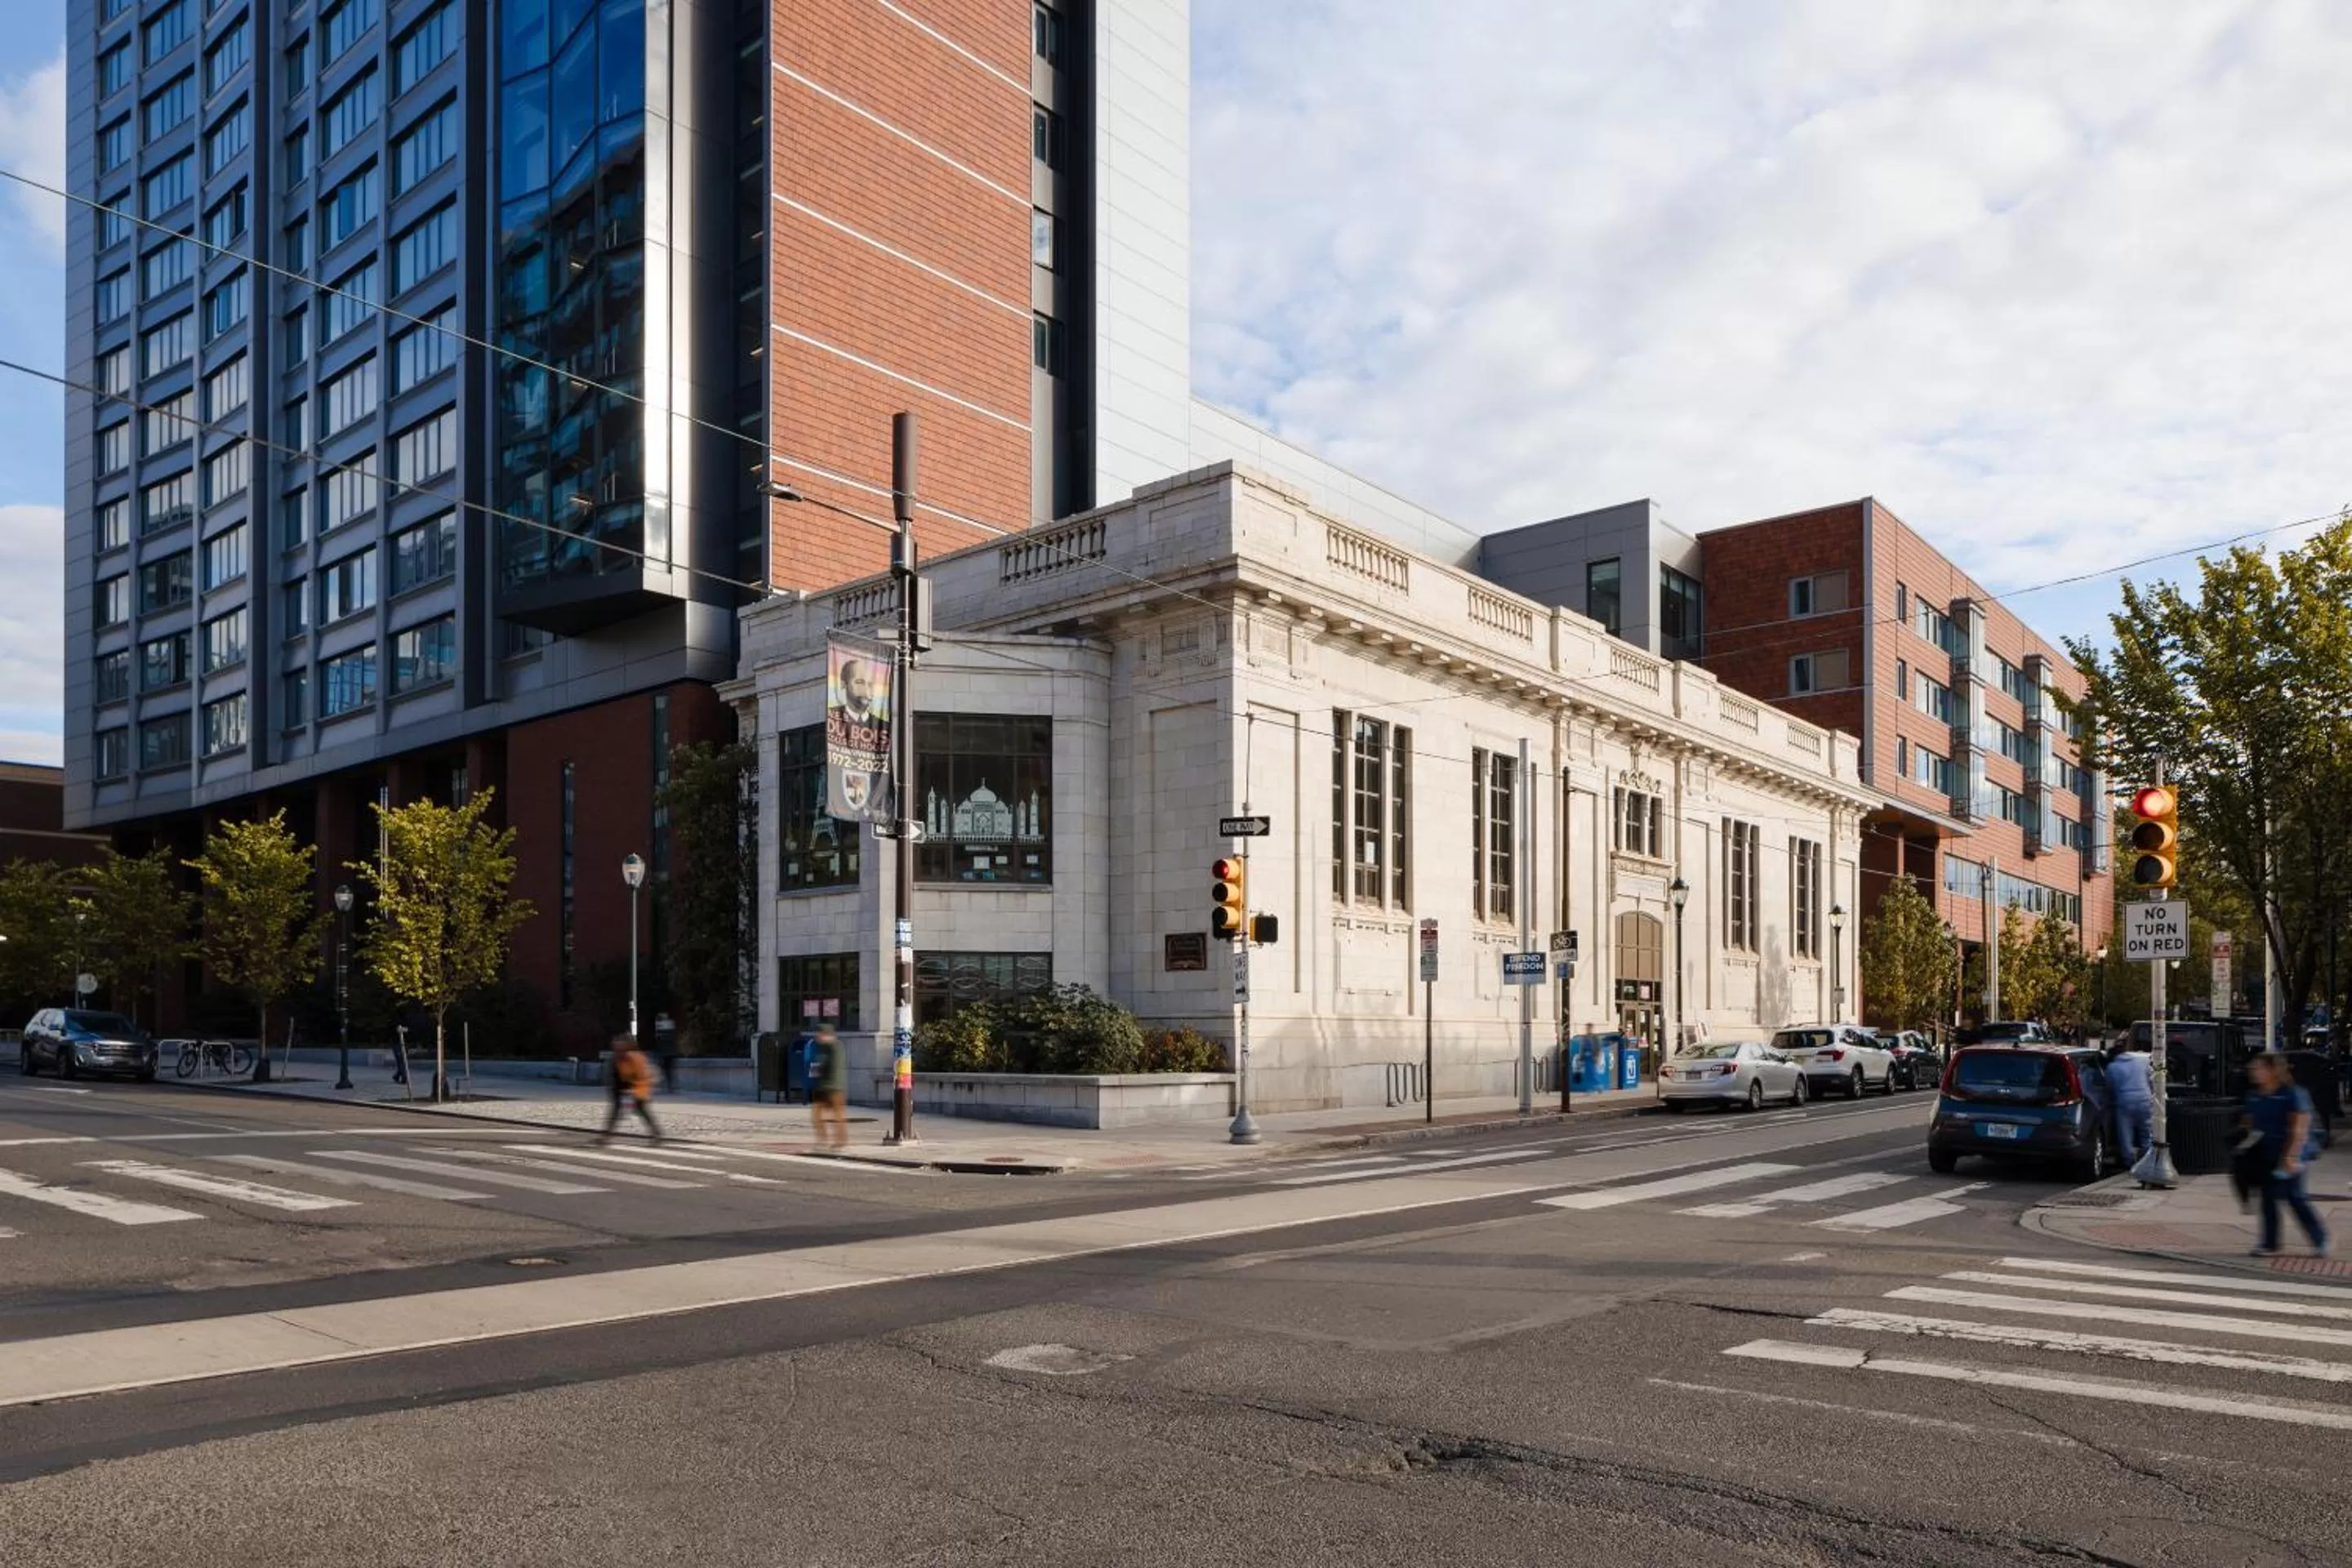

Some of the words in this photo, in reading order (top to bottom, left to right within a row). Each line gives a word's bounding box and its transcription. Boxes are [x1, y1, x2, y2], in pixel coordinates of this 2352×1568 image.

[827, 719, 846, 737] DU
[851, 724, 889, 744] BOIS
[2145, 907, 2166, 920] NO
[2136, 923, 2177, 936] TURN
[2128, 940, 2148, 951] ON
[2154, 938, 2184, 951] RED
